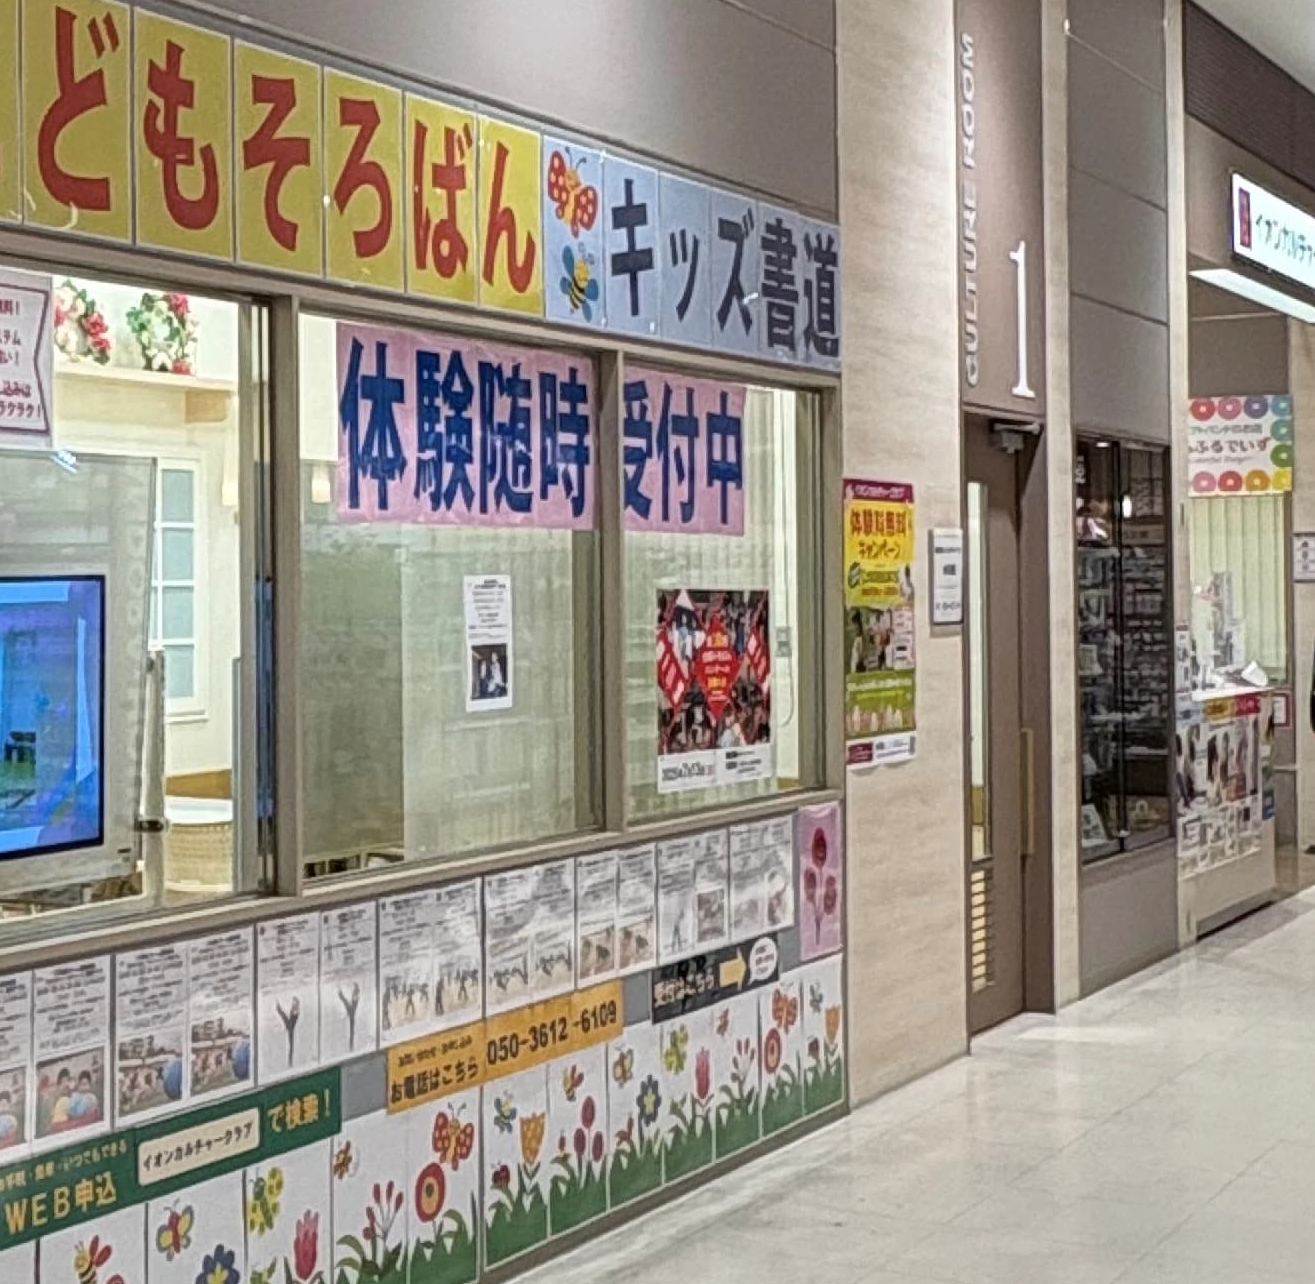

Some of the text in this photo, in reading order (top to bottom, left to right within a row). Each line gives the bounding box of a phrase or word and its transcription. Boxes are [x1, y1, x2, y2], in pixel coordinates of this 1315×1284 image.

[611, 178, 839, 358] キッズ書道
[960, 32, 979, 388] CULTURE ROOM
[1009, 240, 1035, 397] 1
[339, 337, 743, 525] 体験随時 受付中
[142, 1088, 330, 1172] イオンカルチャークラブ で検索！
[391, 1056, 478, 1103] お電話はこちら
[4, 1170, 117, 1235] WEB申込
